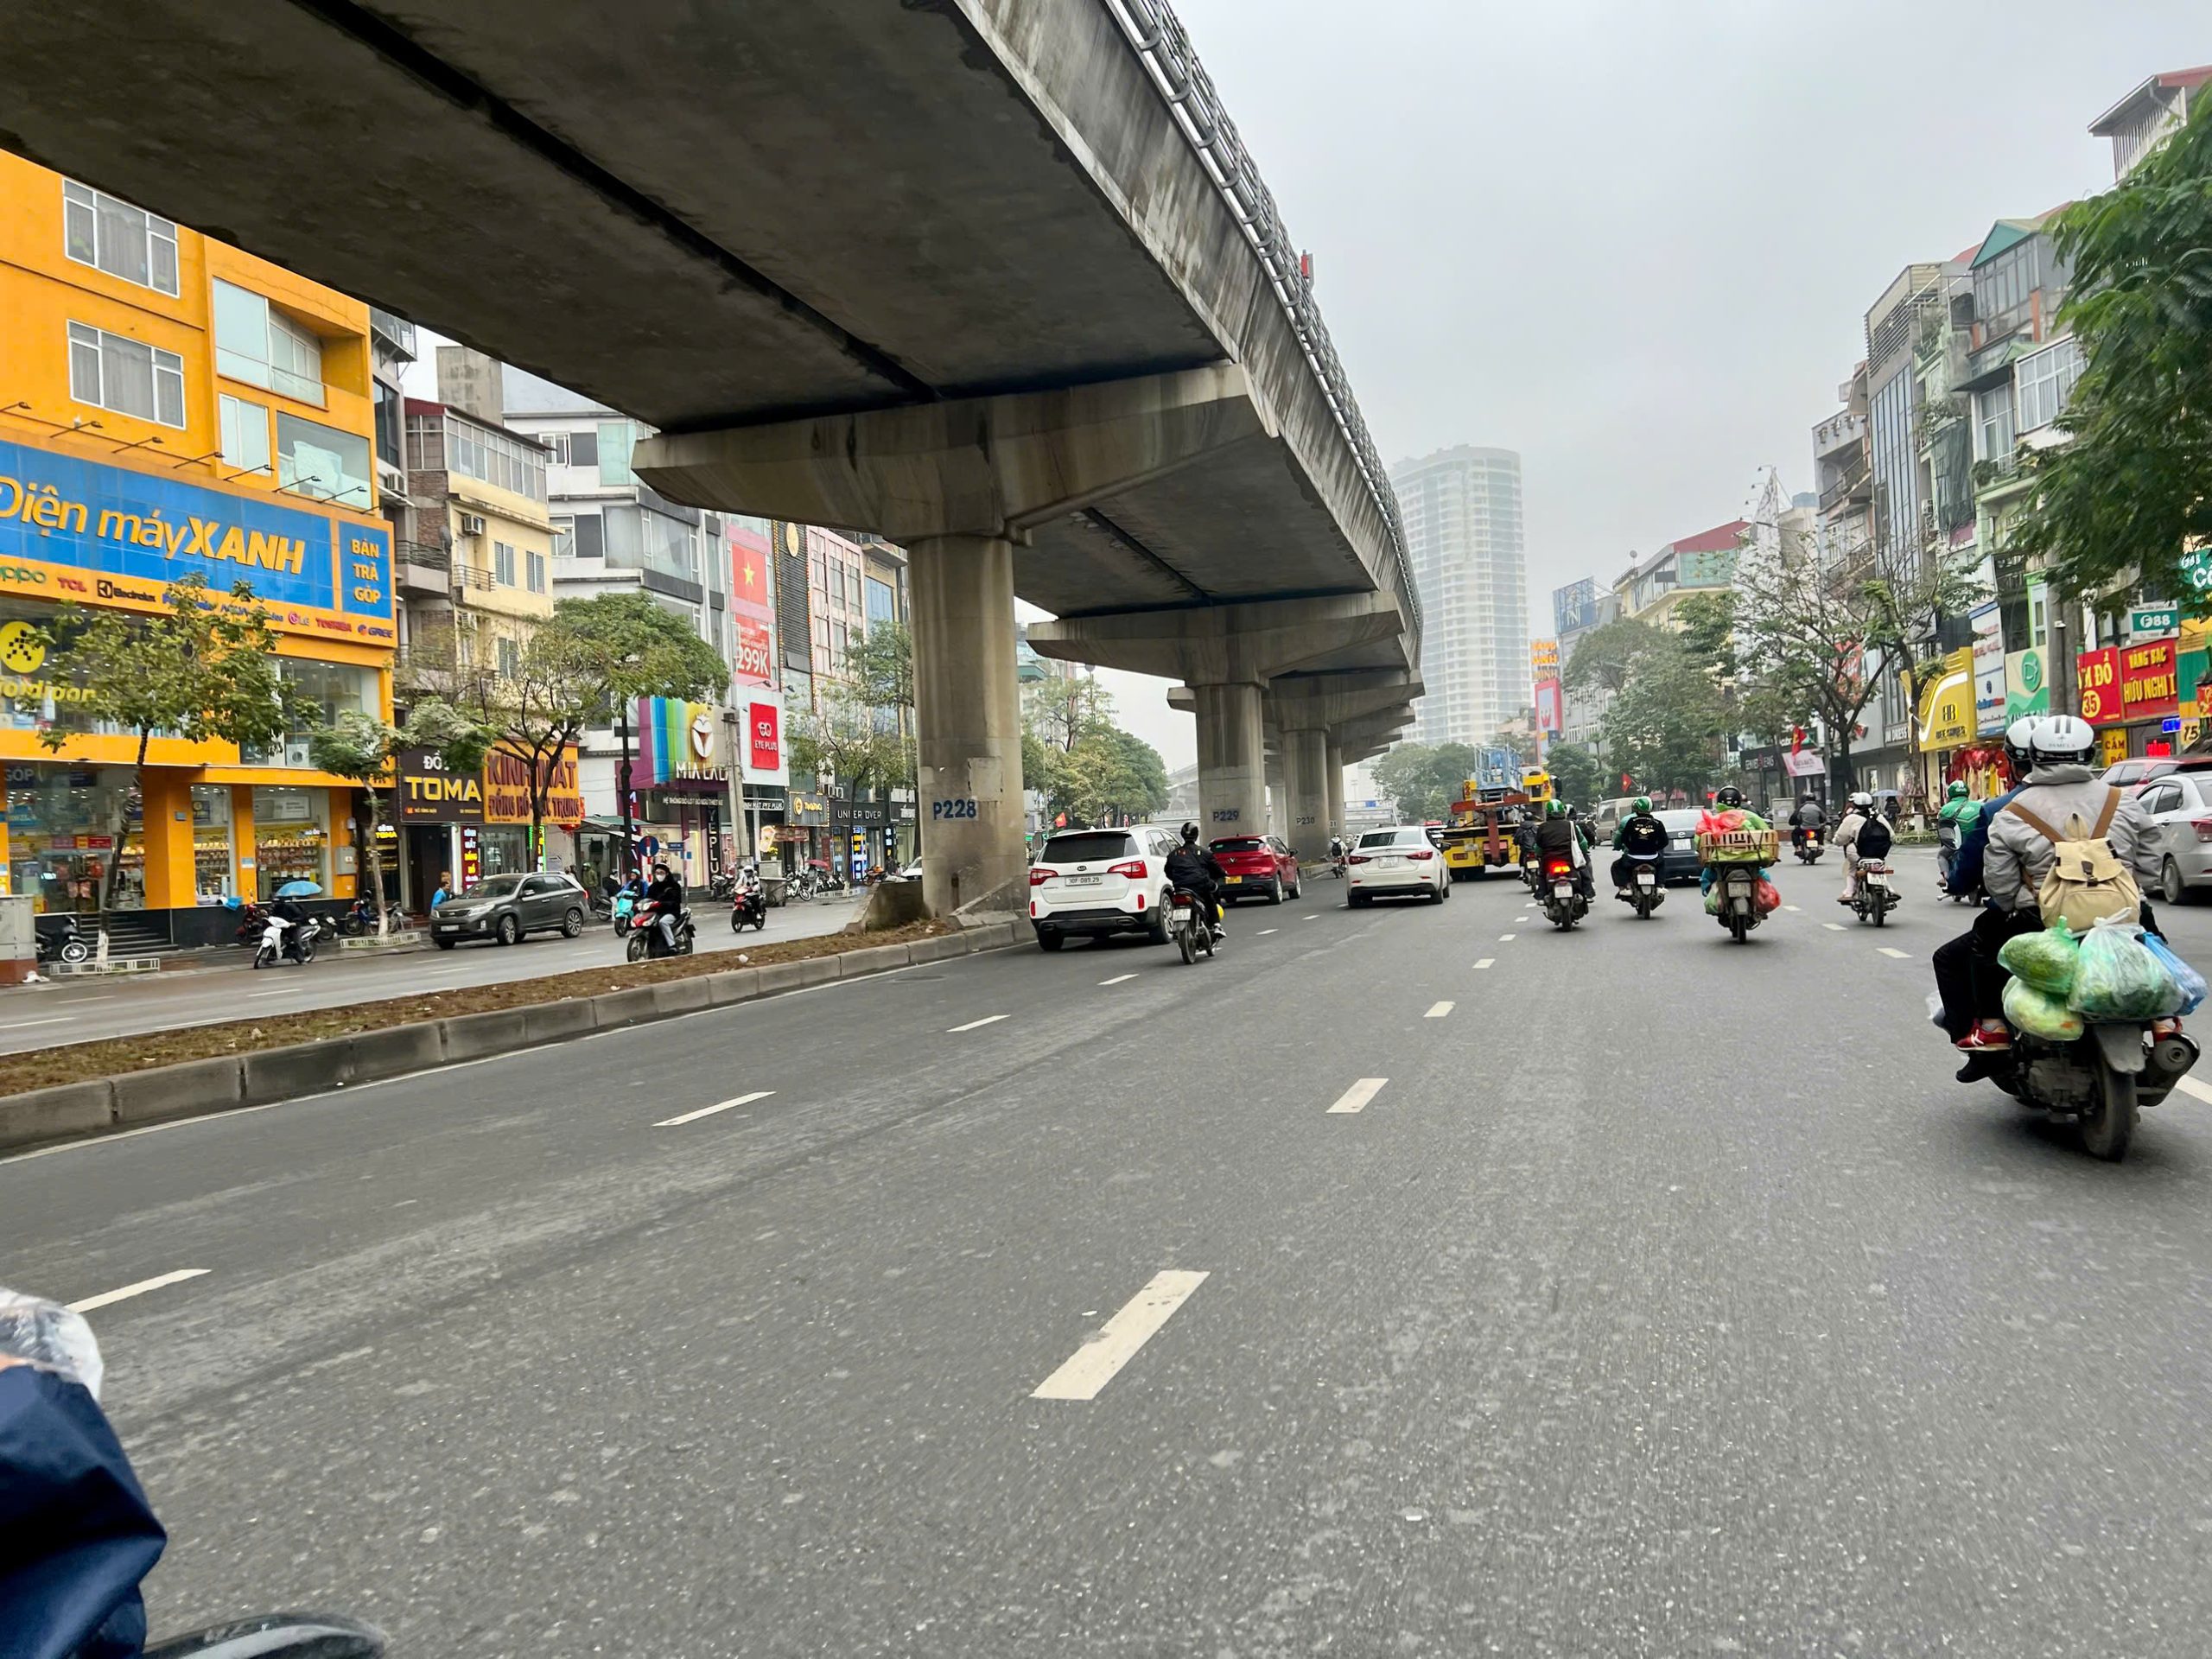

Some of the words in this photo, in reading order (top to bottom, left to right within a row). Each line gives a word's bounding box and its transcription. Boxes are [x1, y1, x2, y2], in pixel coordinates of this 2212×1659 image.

[183, 516, 306, 575] XANH
[351, 537, 380, 558] BÁN
[353, 562, 378, 582] TRẢ
[353, 586, 381, 605] GÓP
[57, 576, 87, 593] TCL
[315, 618, 352, 632] TOSHIBA
[368, 627, 393, 638] GREE
[2140, 614, 2171, 628] F88
[2083, 695, 2097, 714] 35
[404, 776, 482, 802] TOMA
[551, 798, 580, 819] TRUNG
[837, 810, 862, 819] UNER
[865, 810, 882, 819] OVER
[933, 799, 977, 820] P228
[1212, 810, 1240, 822] P229
